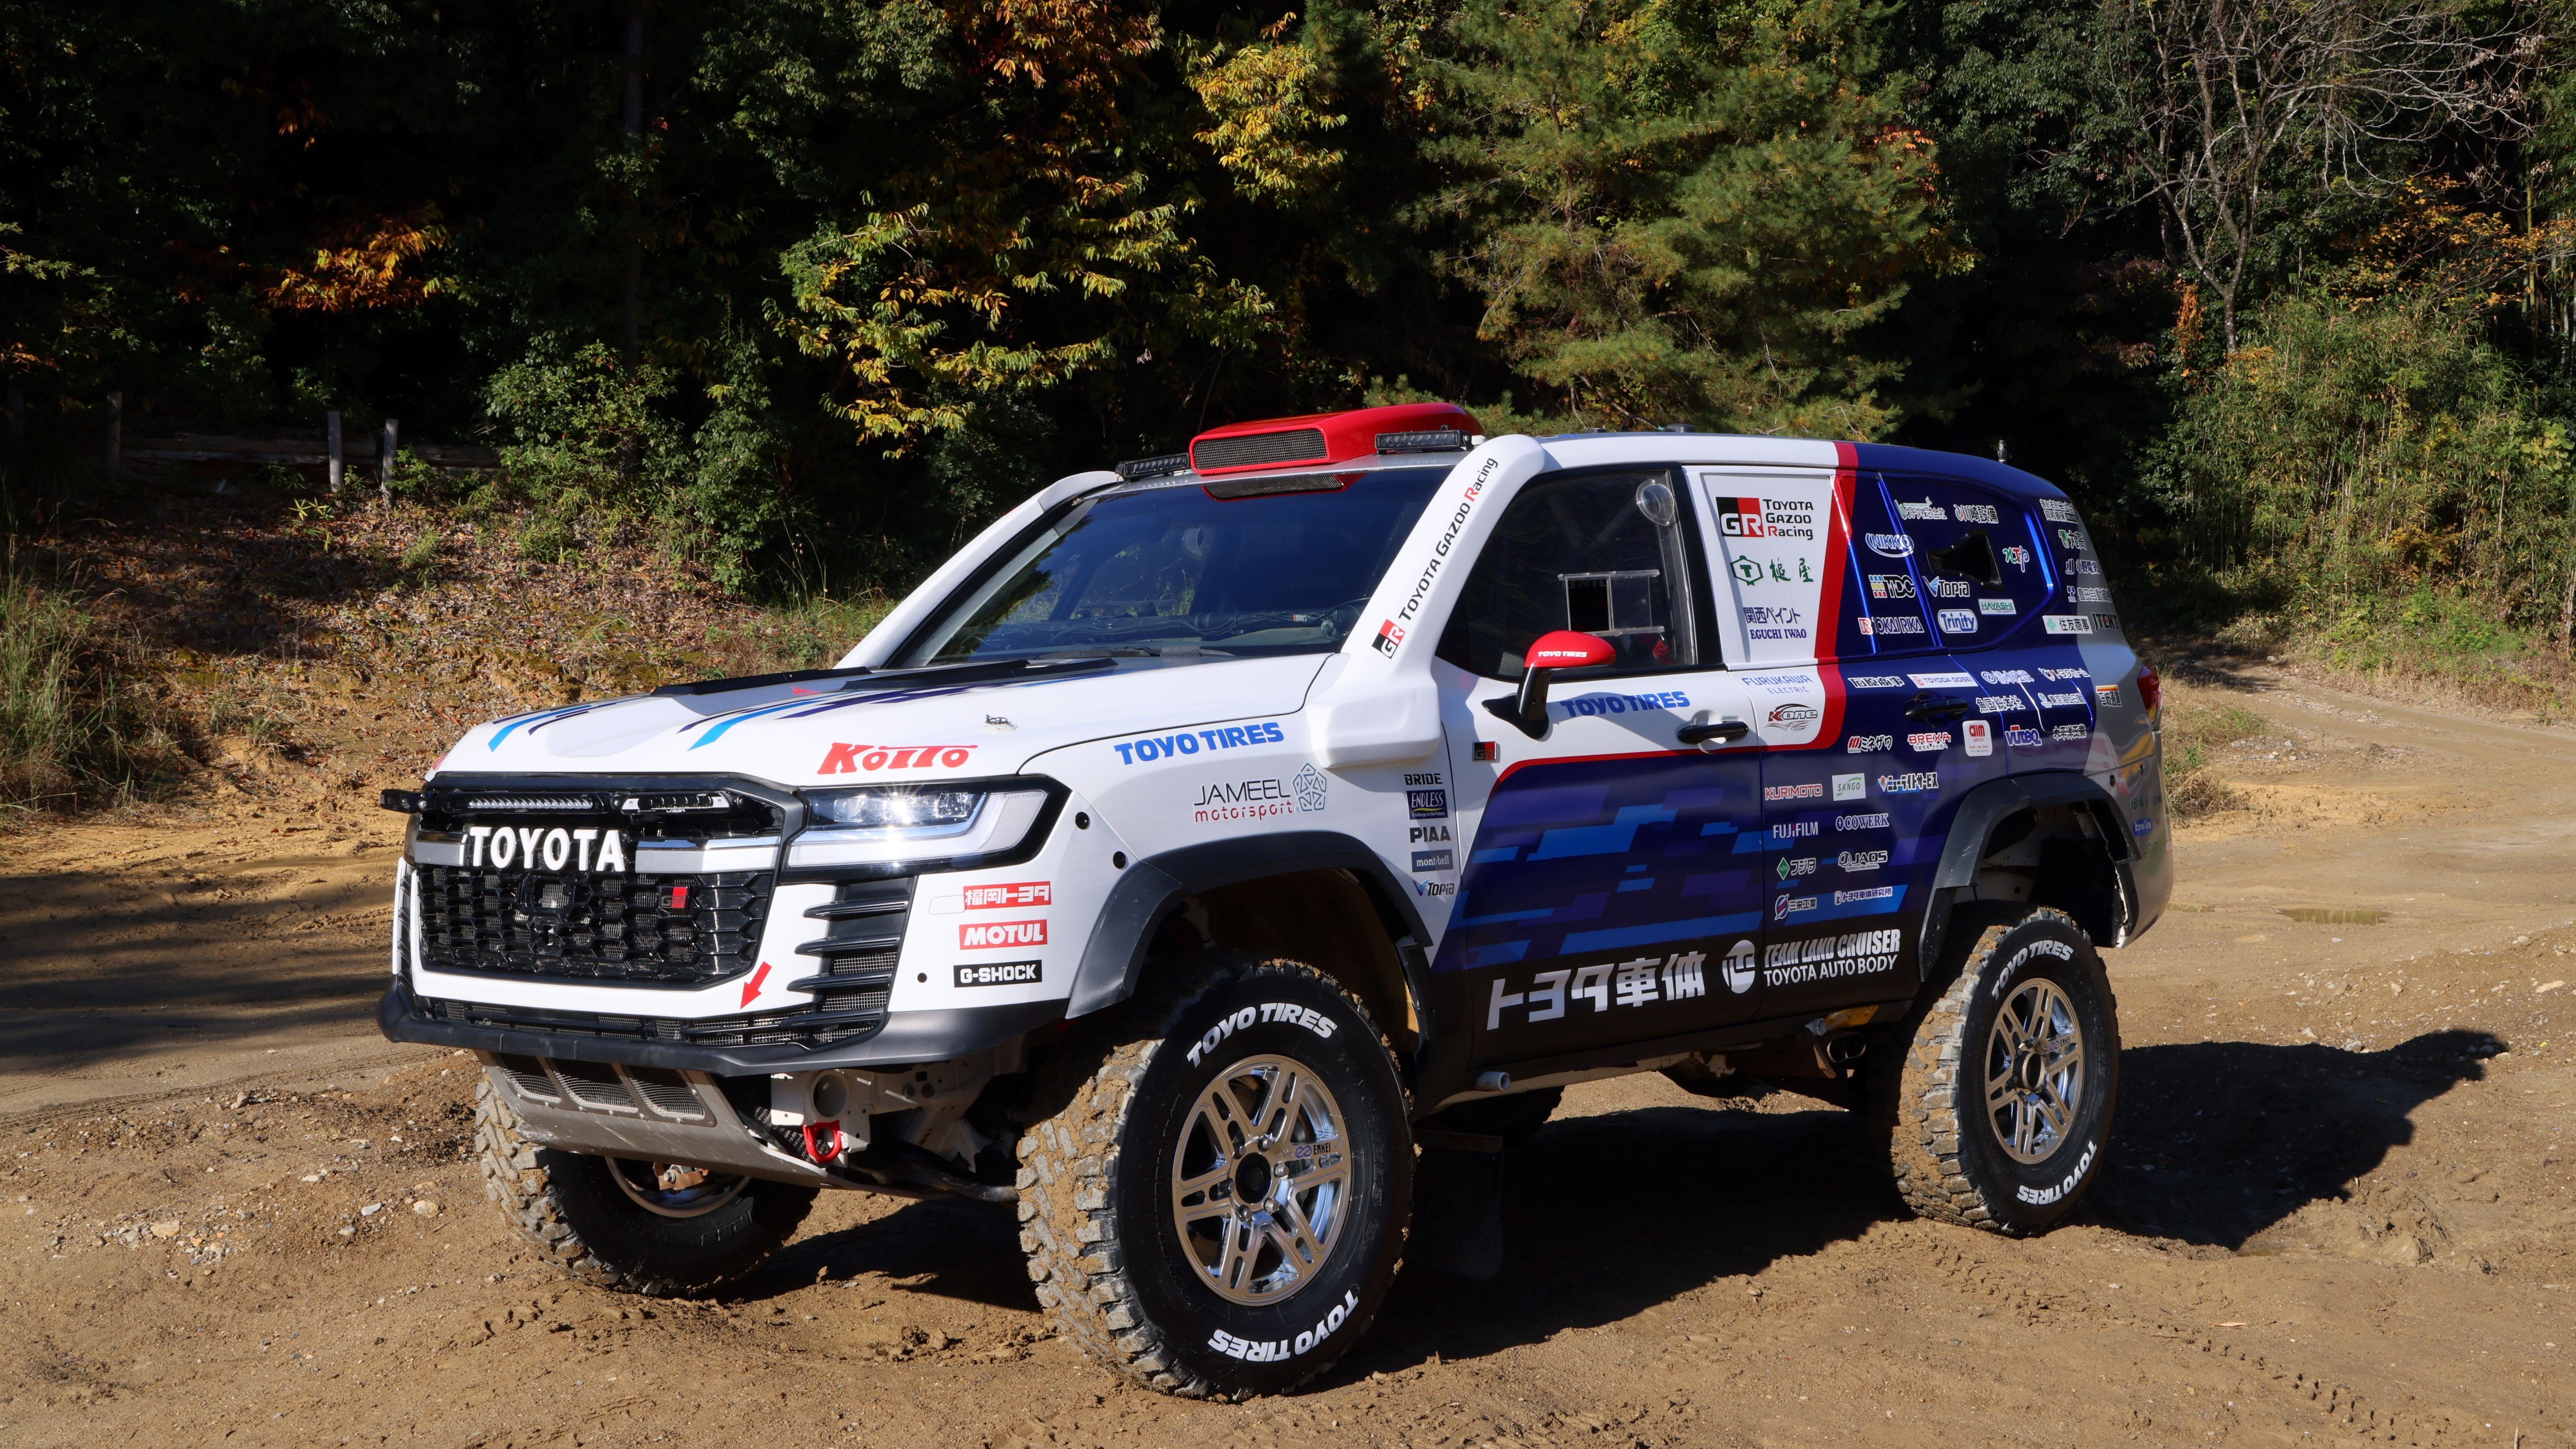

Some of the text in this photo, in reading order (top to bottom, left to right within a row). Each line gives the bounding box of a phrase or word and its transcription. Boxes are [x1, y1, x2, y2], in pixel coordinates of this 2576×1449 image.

[1763, 499, 1814, 510] TOYOTA
[1766, 513, 1811, 523] GAZOO
[1399, 457, 1499, 620] TOYOTA GAZOO Racing
[1768, 526, 1813, 540] Racing
[1871, 534, 1912, 549] NIKKO
[1882, 575, 1916, 598] TDC
[1743, 607, 1801, 624] 関西ペイント
[1940, 613, 1974, 631] Trinity
[2091, 613, 2119, 632] JTEKT
[1900, 617, 1924, 633] RIKA
[2059, 618, 2089, 632] 住友商事
[1750, 629, 1806, 639] EGUCHI IWAO
[1741, 675, 1814, 686] FURUKAWA
[2051, 668, 2090, 679] トヨタホーム
[1767, 686, 1810, 694] ELECTRIC
[1849, 676, 1904, 688] 石原商事
[1559, 691, 1690, 718] TOYO TIRES
[1976, 695, 2026, 713] 魚国総本社
[1114, 722, 1284, 766] TOYO TIRES
[1862, 736, 1892, 751] ミネザワ
[1908, 733, 1950, 744] BREXA
[1404, 773, 1443, 785] BRIDE
[1837, 782, 1860, 792] SANGO
[1887, 773, 1939, 792] ニューライトサービス
[1194, 779, 1291, 806] JAMEEL
[1412, 792, 1444, 808] ENDLESS
[1765, 784, 1823, 800] KURIMOTO
[1195, 801, 1292, 822] motorsport
[1844, 814, 1889, 830] COWERK
[1410, 826, 1451, 843] PIAA
[1773, 822, 1819, 839] FUJIFILM
[469, 826, 625, 872] TOYOTA
[1851, 851, 1887, 865] JAOS
[1790, 859, 1816, 875] フジタ
[965, 885, 1049, 907] 福岡トヨタ
[1842, 888, 1892, 901] トヨタ車体研究所
[1789, 898, 1817, 912] 三栄工業
[963, 922, 1044, 946] MOTUL
[1765, 929, 1901, 968] TEAM LAND CRUISER
[960, 964, 1037, 982] G-SHOCK
[1764, 955, 1898, 987] TOYOTA AUTO BODY
[1992, 939, 2074, 1001] TOYO TIRES
[1487, 951, 1707, 1031] トヨタ車体
[1186, 1002, 1338, 1069] TOYO TIRES
[2060, 1036, 2071, 1046] ENKEI
[1313, 1142, 1331, 1155] ENKEI
[2016, 1140, 2097, 1205] TOYO TIRES
[1207, 1289, 1360, 1362] TOYO TIRES
